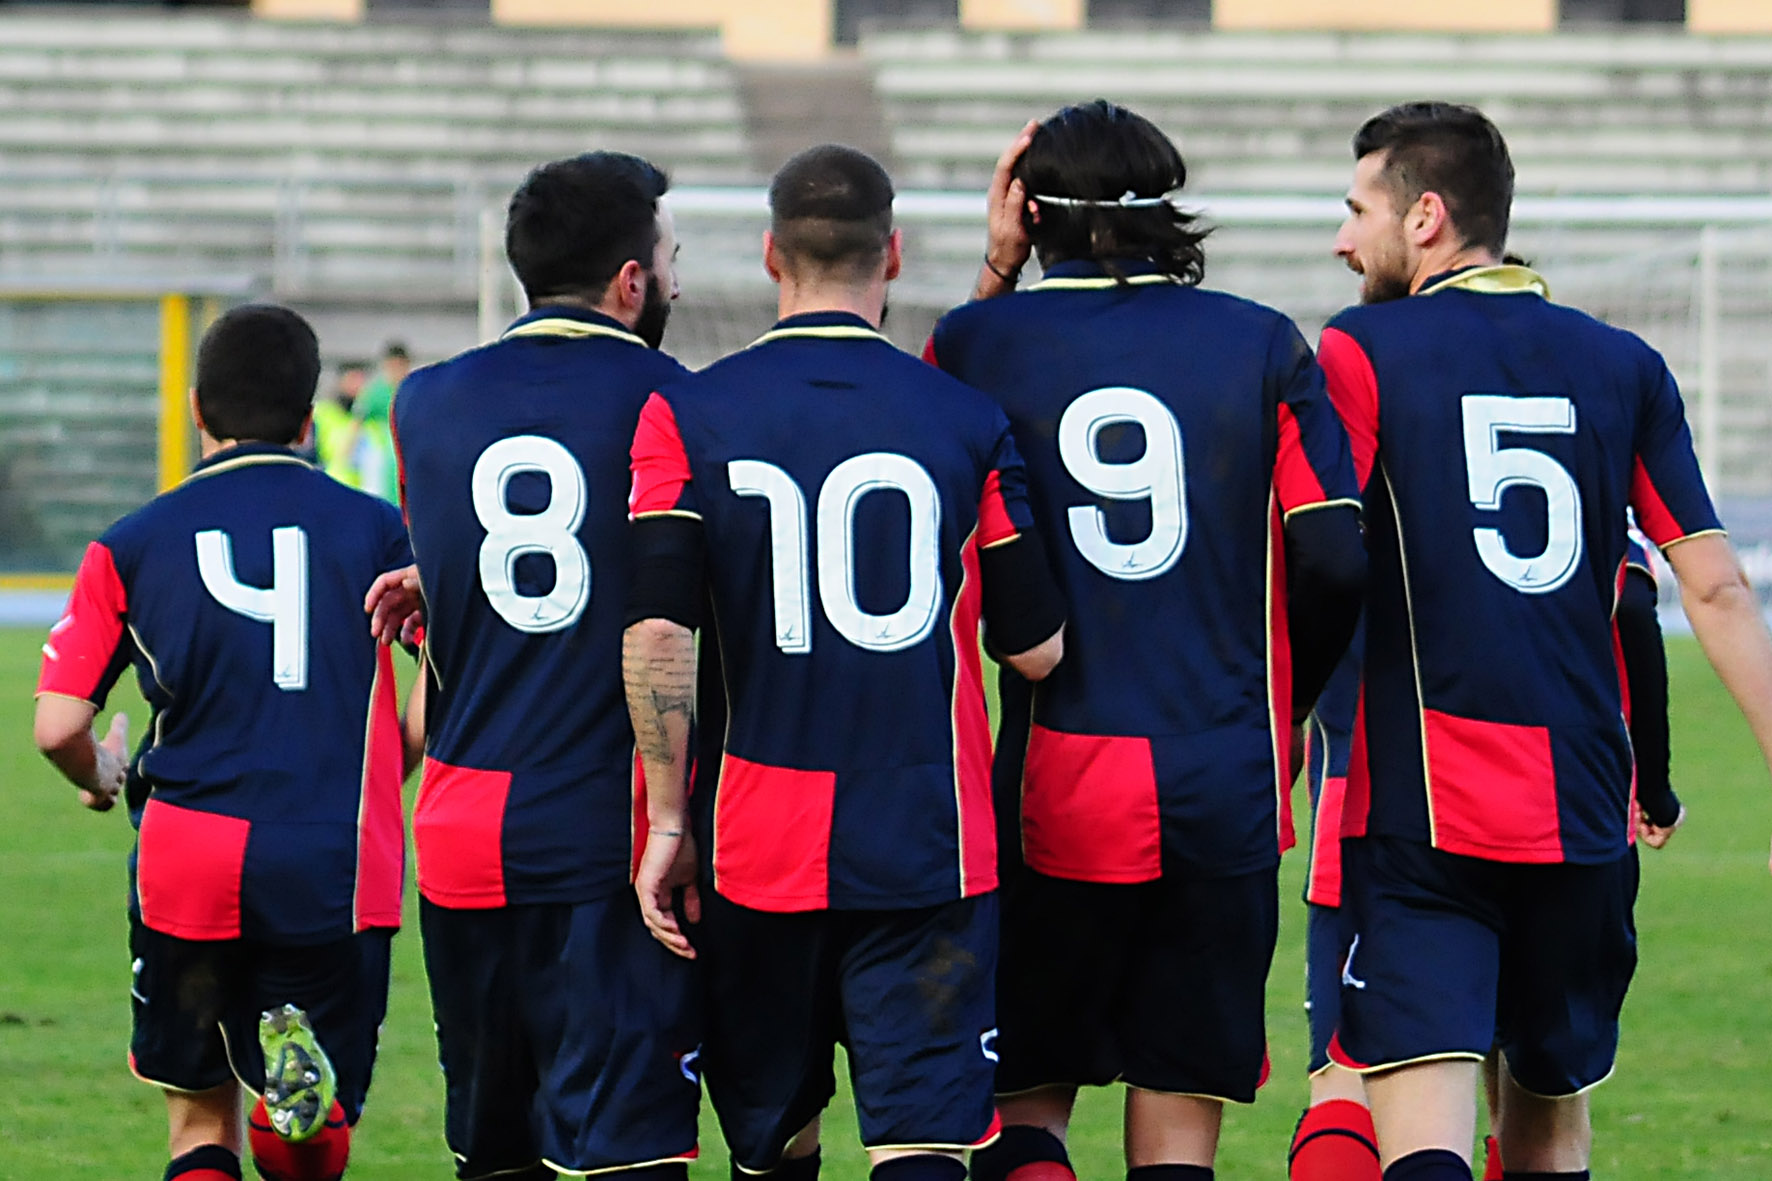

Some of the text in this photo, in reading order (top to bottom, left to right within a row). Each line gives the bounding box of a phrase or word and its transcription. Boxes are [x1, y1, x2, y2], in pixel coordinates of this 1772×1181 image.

[472, 435, 591, 634] 8
[728, 452, 941, 655] 10
[1059, 387, 1189, 581] 9
[1461, 395, 1583, 594] 5
[196, 526, 307, 690] 4
